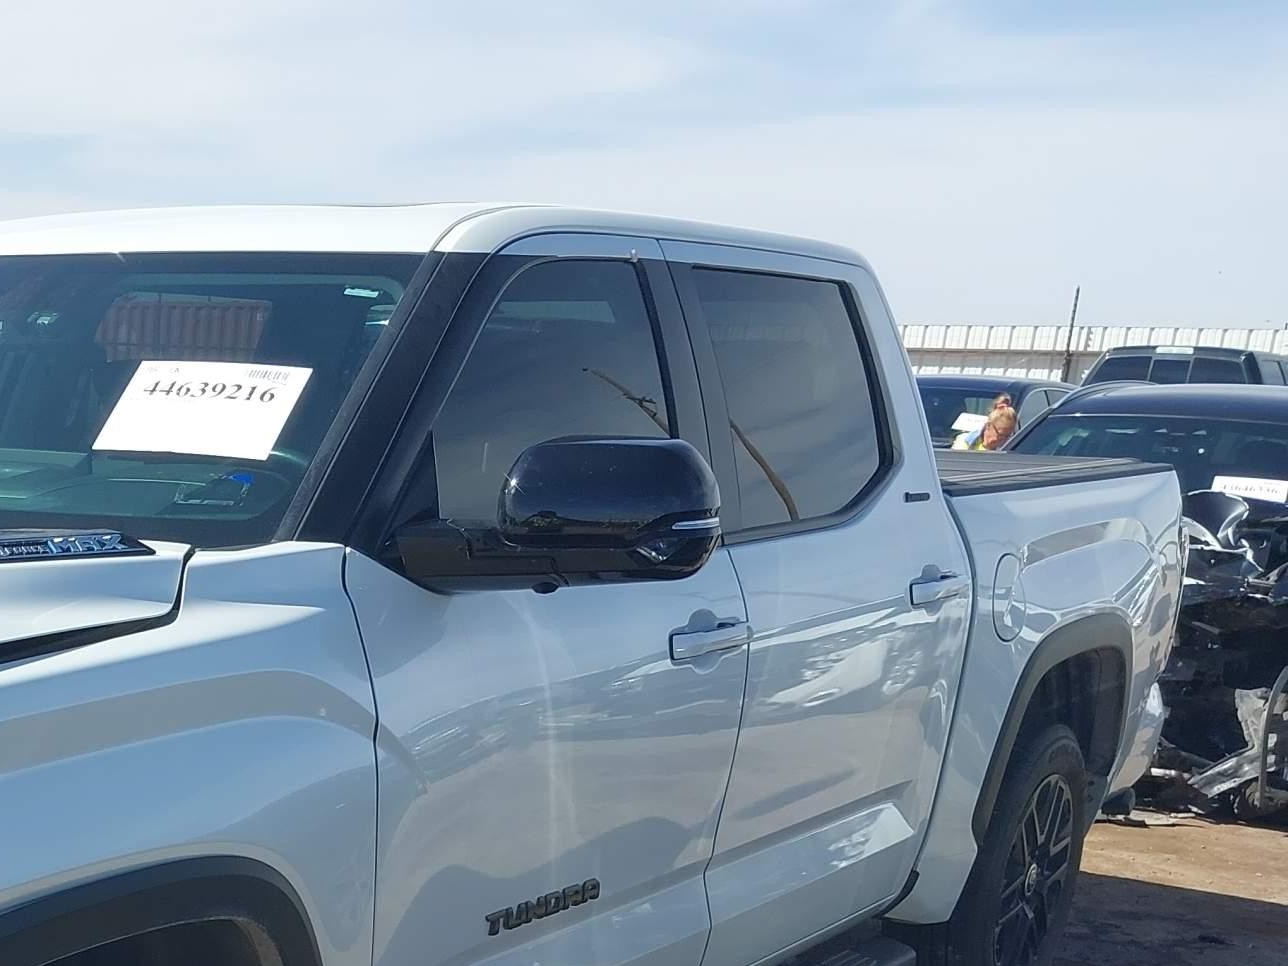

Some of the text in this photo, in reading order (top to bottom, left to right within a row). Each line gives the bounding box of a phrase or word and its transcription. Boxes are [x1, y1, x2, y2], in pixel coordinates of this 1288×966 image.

[143, 380, 277, 403] 44639216
[48, 534, 129, 554] MAX
[485, 878, 601, 936] TUNDRA
